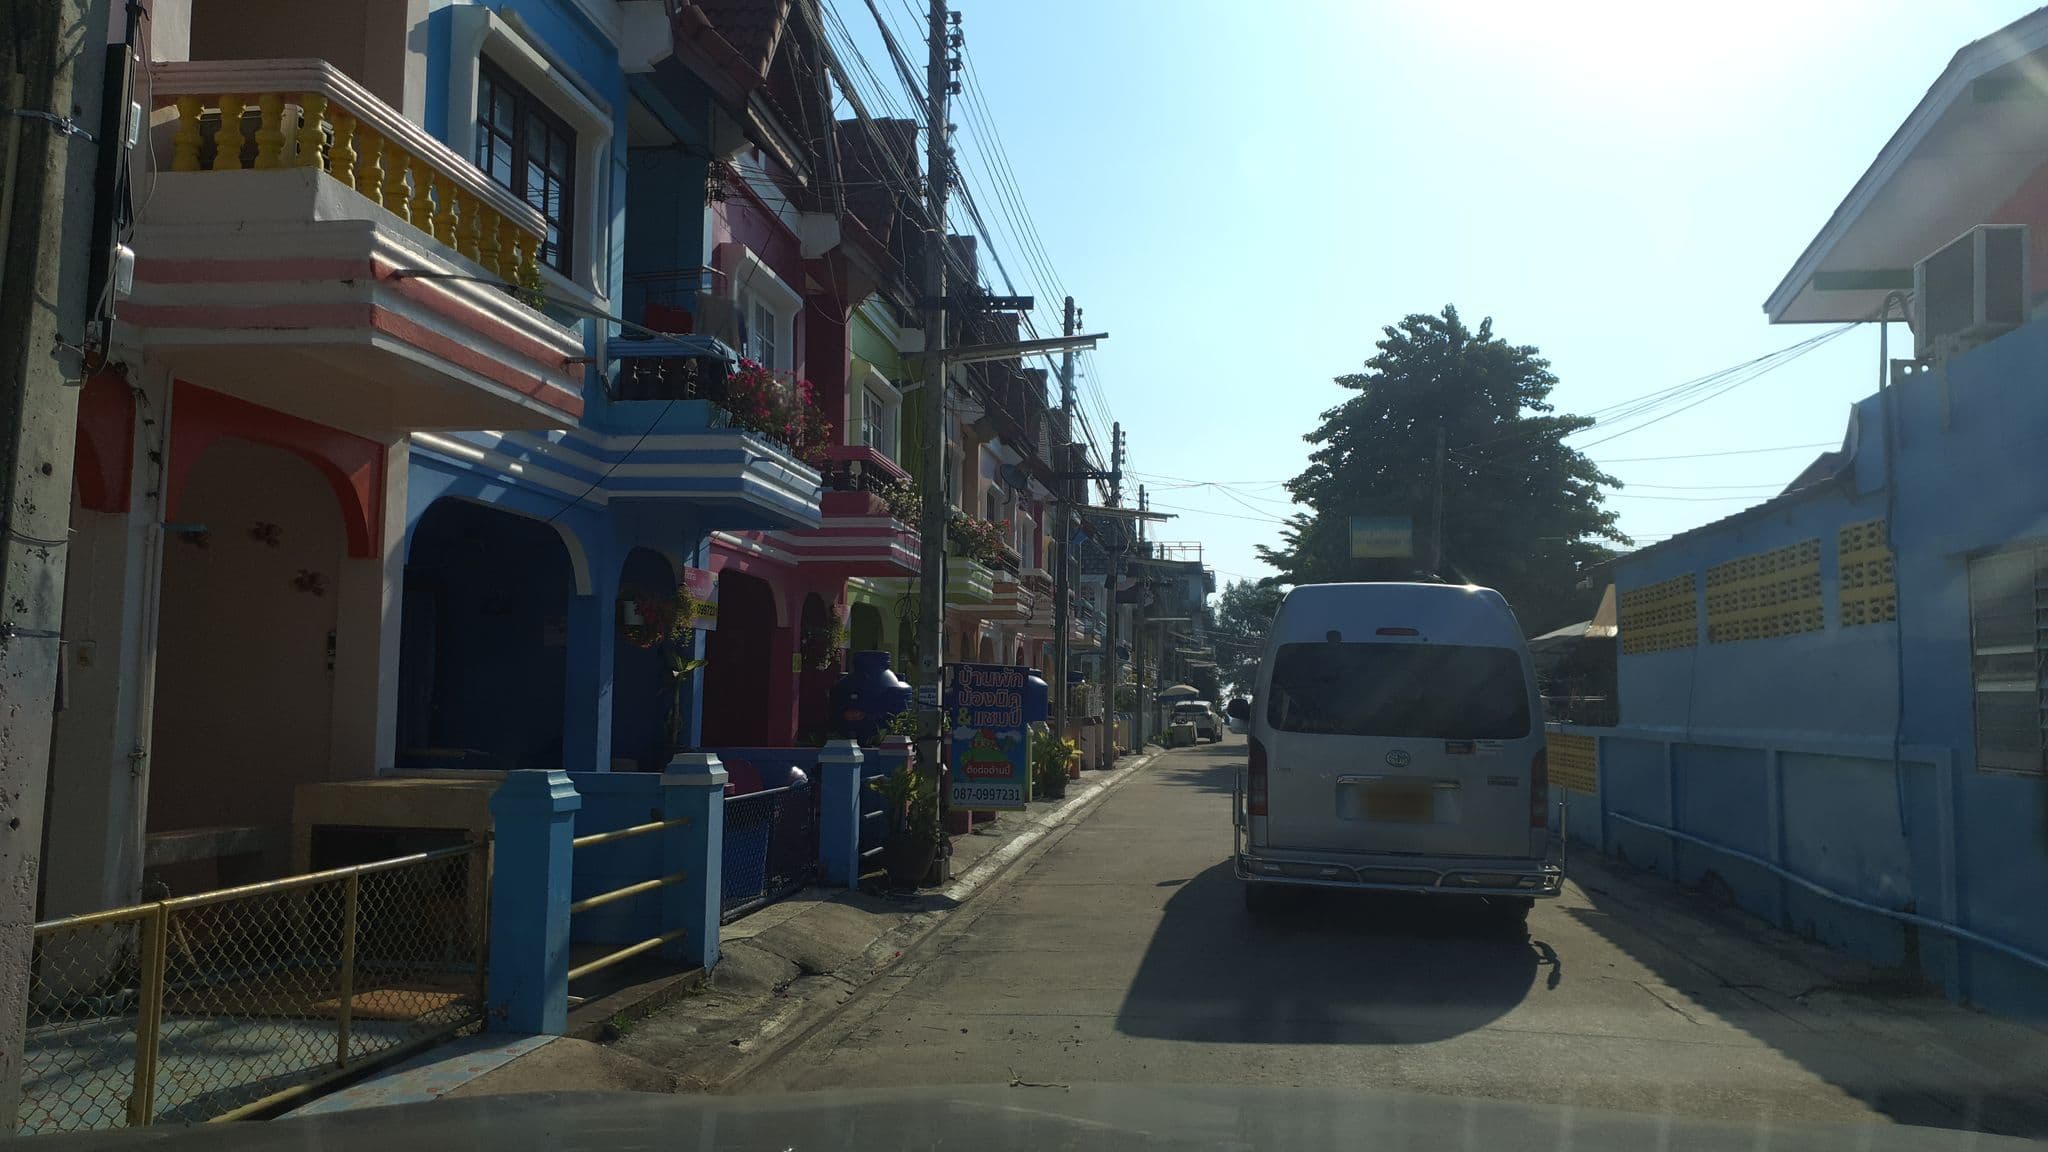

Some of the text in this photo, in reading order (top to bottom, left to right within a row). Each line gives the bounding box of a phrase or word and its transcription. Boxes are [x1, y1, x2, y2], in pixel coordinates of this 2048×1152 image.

[959, 665, 1024, 688] บ้านพัก
[958, 708, 972, 725] &
[953, 788, 1021, 801] 087-0997231
